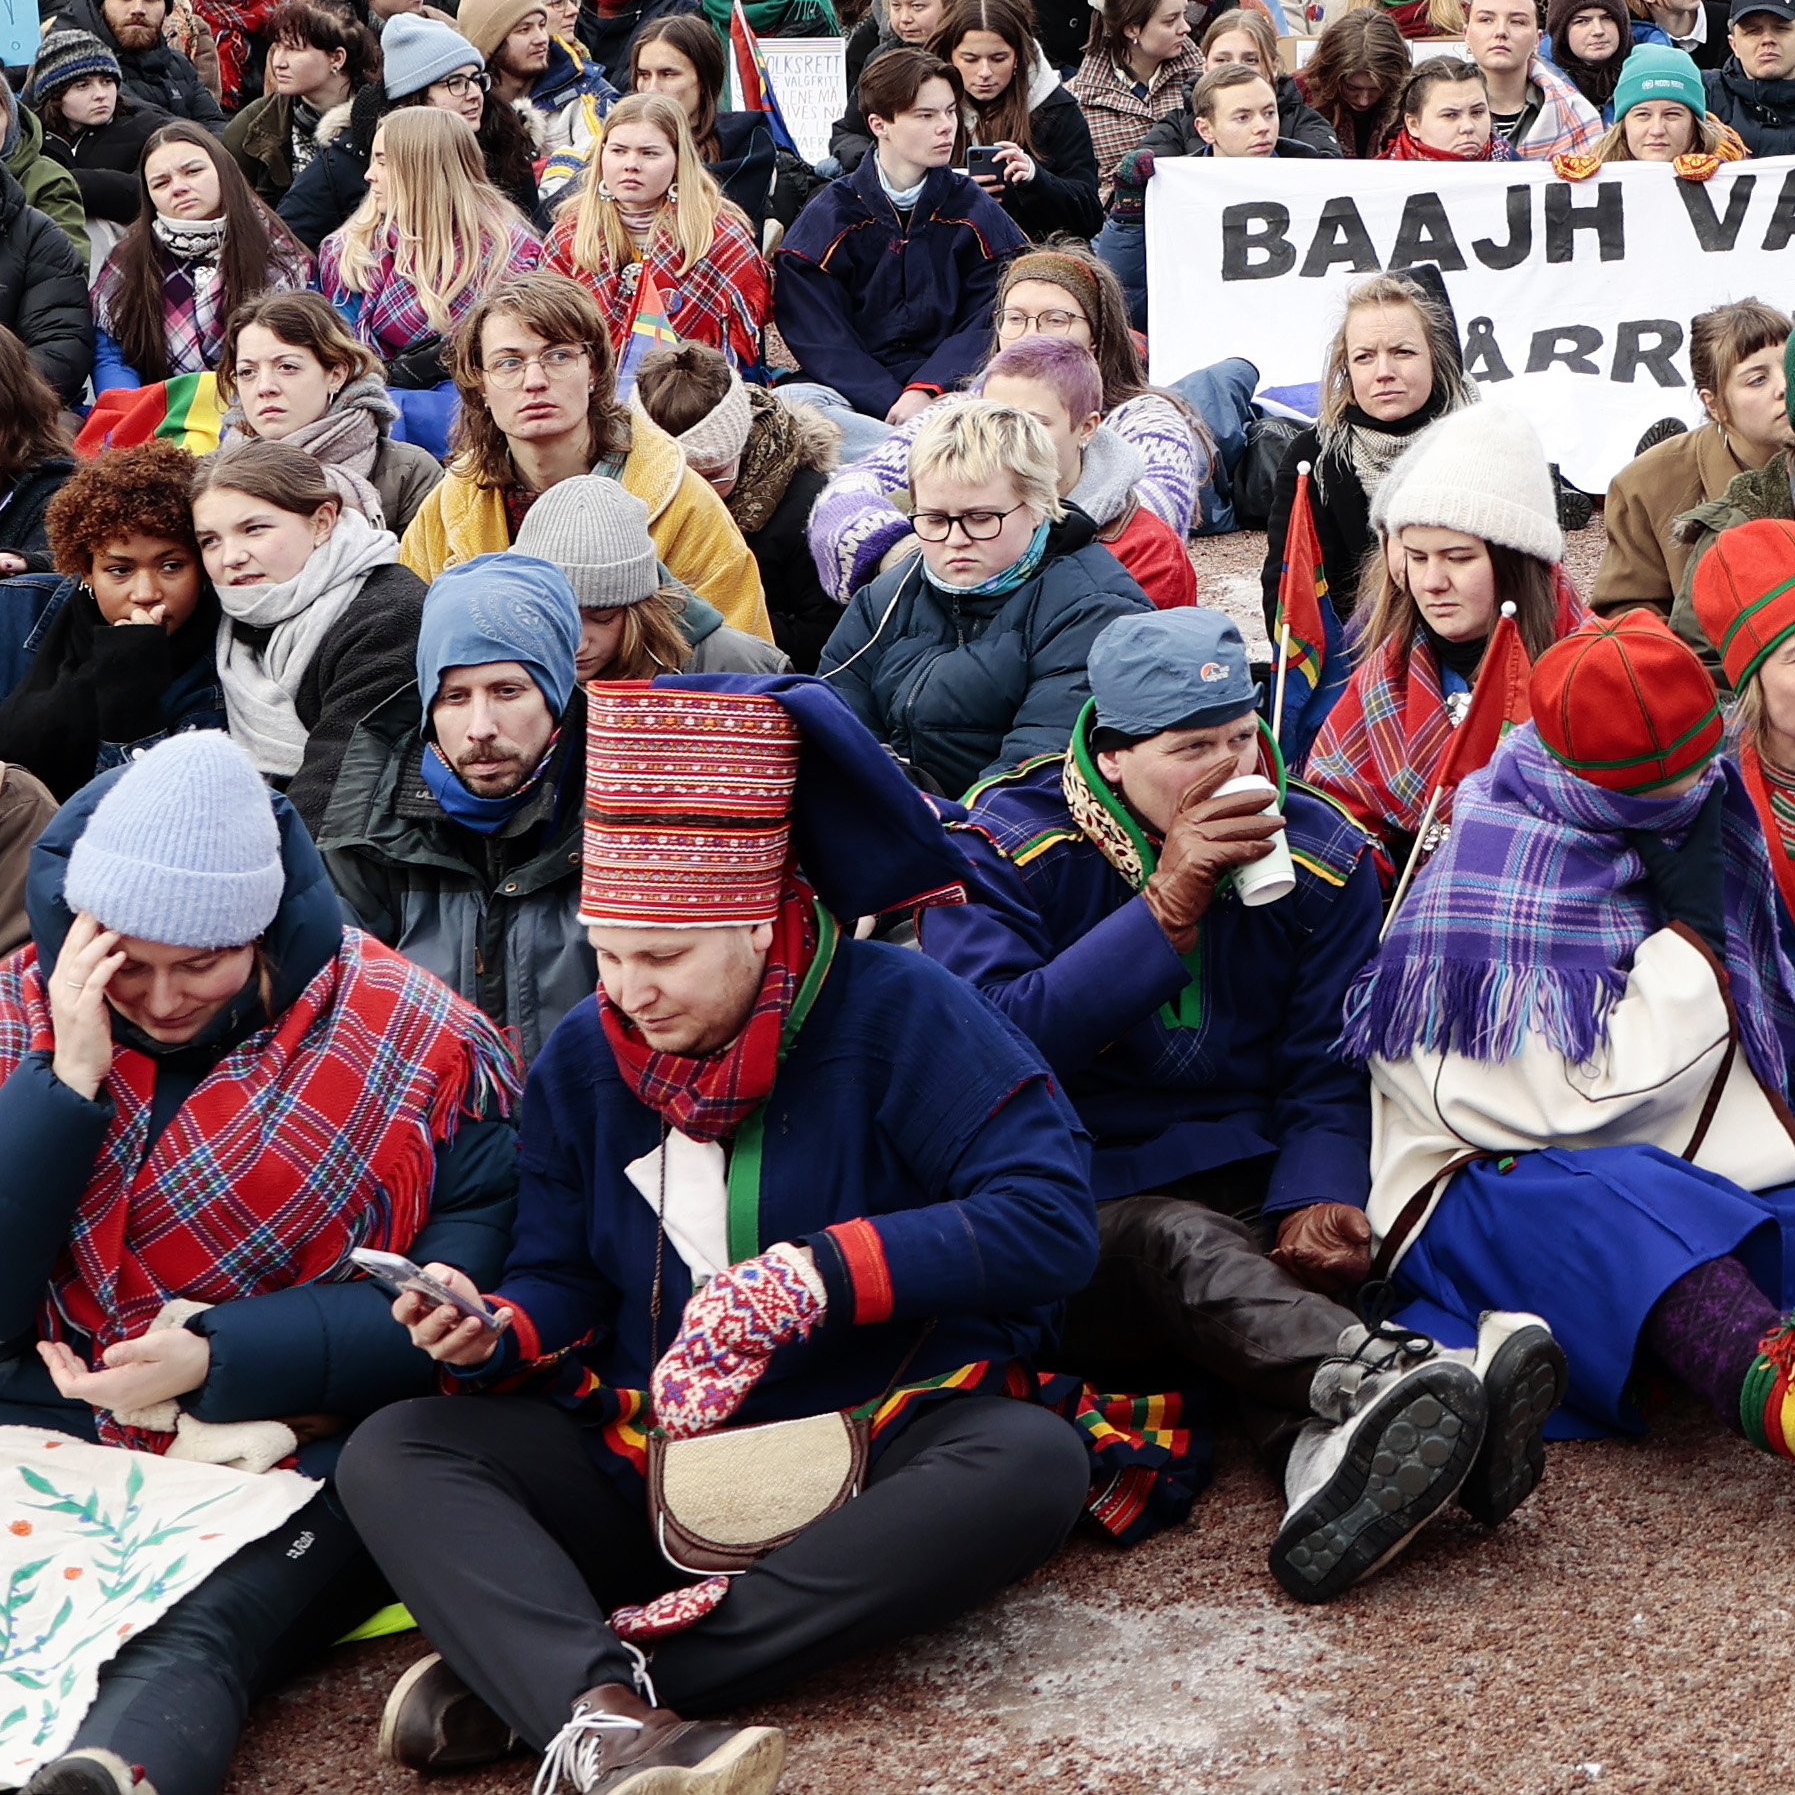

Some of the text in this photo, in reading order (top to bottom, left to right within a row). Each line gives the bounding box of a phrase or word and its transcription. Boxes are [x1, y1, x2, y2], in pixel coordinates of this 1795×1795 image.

[766, 55, 842, 74] OLKSRETT
[784, 75, 840, 88] VALGFRITT
[818, 86, 838, 103] MÅ
[1220, 181, 1625, 281] BAAJH
